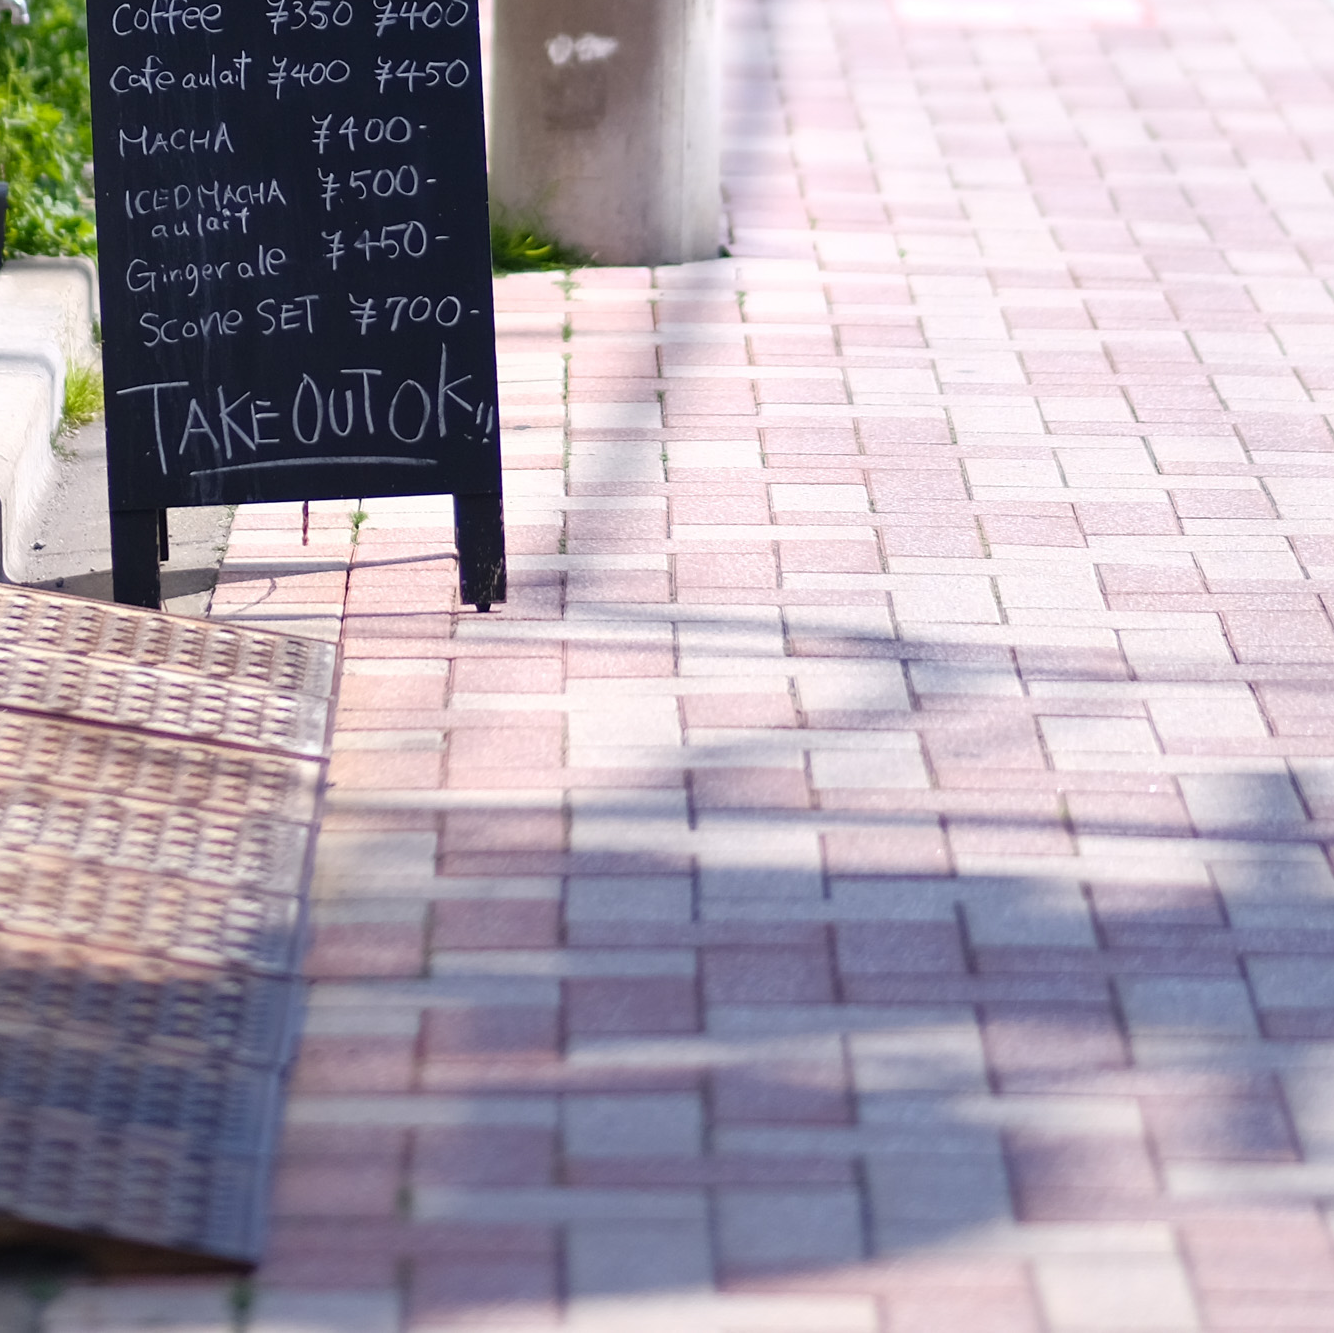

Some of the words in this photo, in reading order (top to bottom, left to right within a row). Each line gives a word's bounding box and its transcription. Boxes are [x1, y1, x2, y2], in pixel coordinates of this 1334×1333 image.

[267, 56, 351, 100] ¥400
[374, 56, 469, 94] ¥450
[119, 122, 234, 157] MACHA
[198, 178, 287, 212] MACHA
[139, 309, 243, 347] Scone
[257, 295, 319, 334] SET
[117, 380, 281, 475] TAKE
[292, 369, 382, 445] OUT
